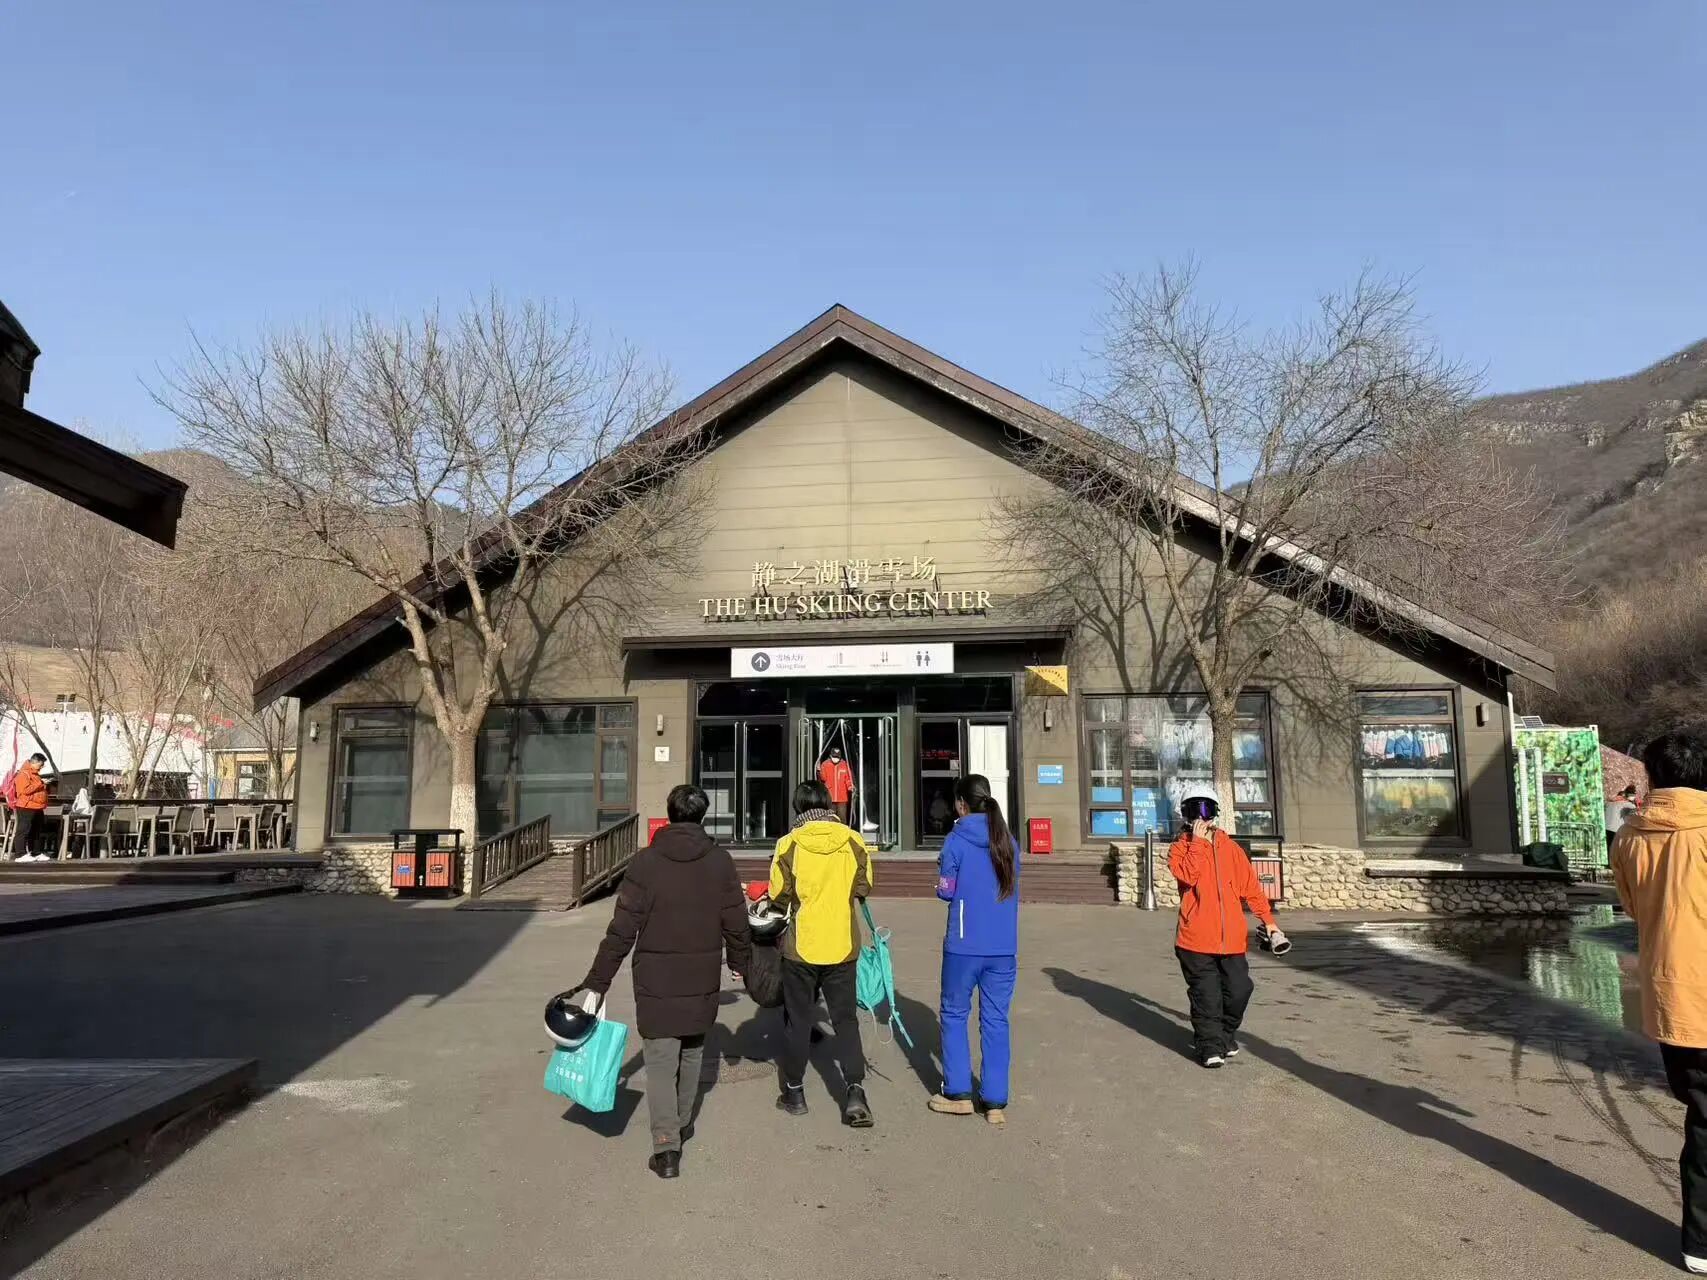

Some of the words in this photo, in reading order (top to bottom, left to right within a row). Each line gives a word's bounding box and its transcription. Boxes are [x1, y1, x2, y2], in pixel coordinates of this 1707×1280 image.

[751, 555, 937, 588] 静之湖滑雪场
[698, 597, 748, 616] THE
[755, 595, 790, 615] HU
[796, 592, 883, 614] SKIING
[889, 589, 993, 612] CENTER
